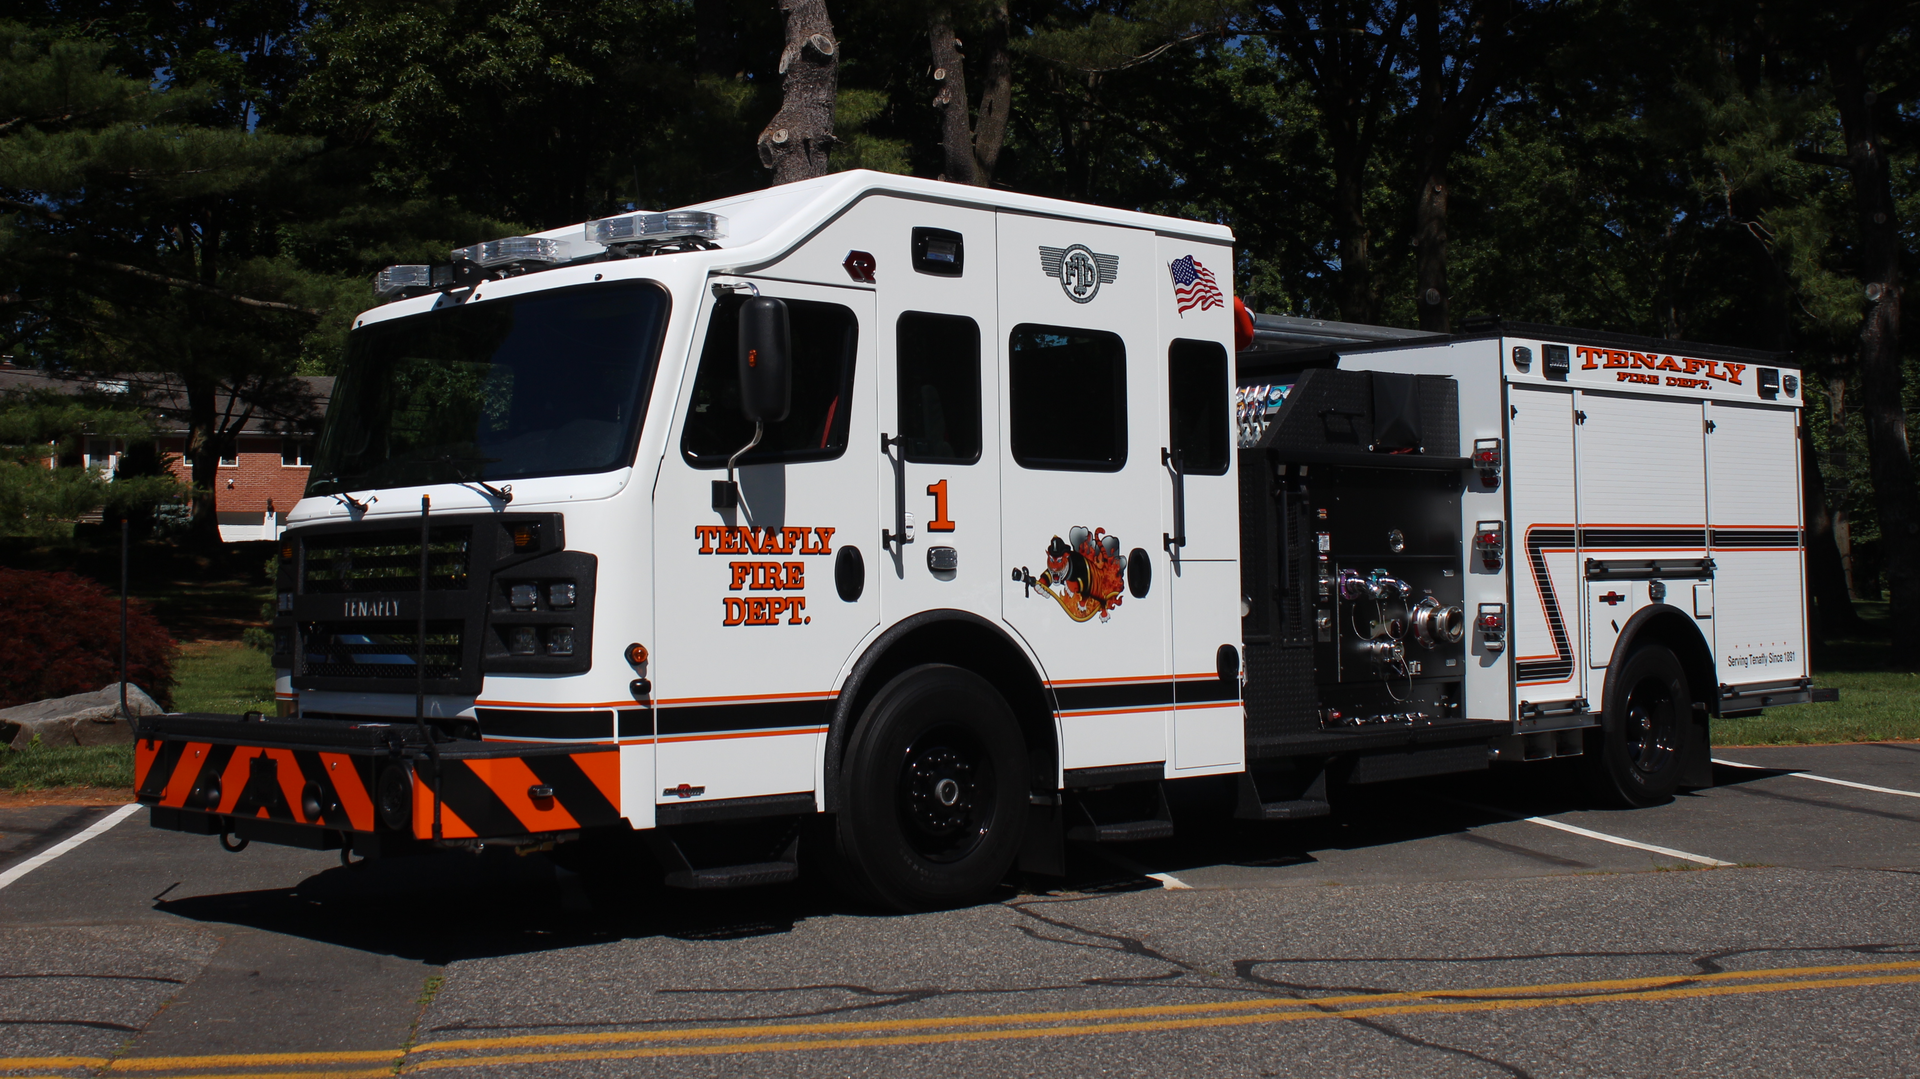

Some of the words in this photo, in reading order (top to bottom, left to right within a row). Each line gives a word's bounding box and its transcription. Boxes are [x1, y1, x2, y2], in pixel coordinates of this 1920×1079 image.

[1576, 346, 1746, 386] TENAFLY
[1617, 371, 1660, 385] FIRE
[1665, 377, 1713, 390] DEPT.
[926, 479, 956, 533] 1
[695, 525, 836, 555] TENAFLY
[729, 561, 805, 591] FIRE
[344, 599, 400, 617] TENAFLY
[722, 596, 812, 627] DEPT.
[1727, 654, 1749, 669] Serving
[1749, 652, 1768, 666] Tenafly
[1768, 651, 1783, 664] Since
[1783, 650, 1796, 663] 1891
